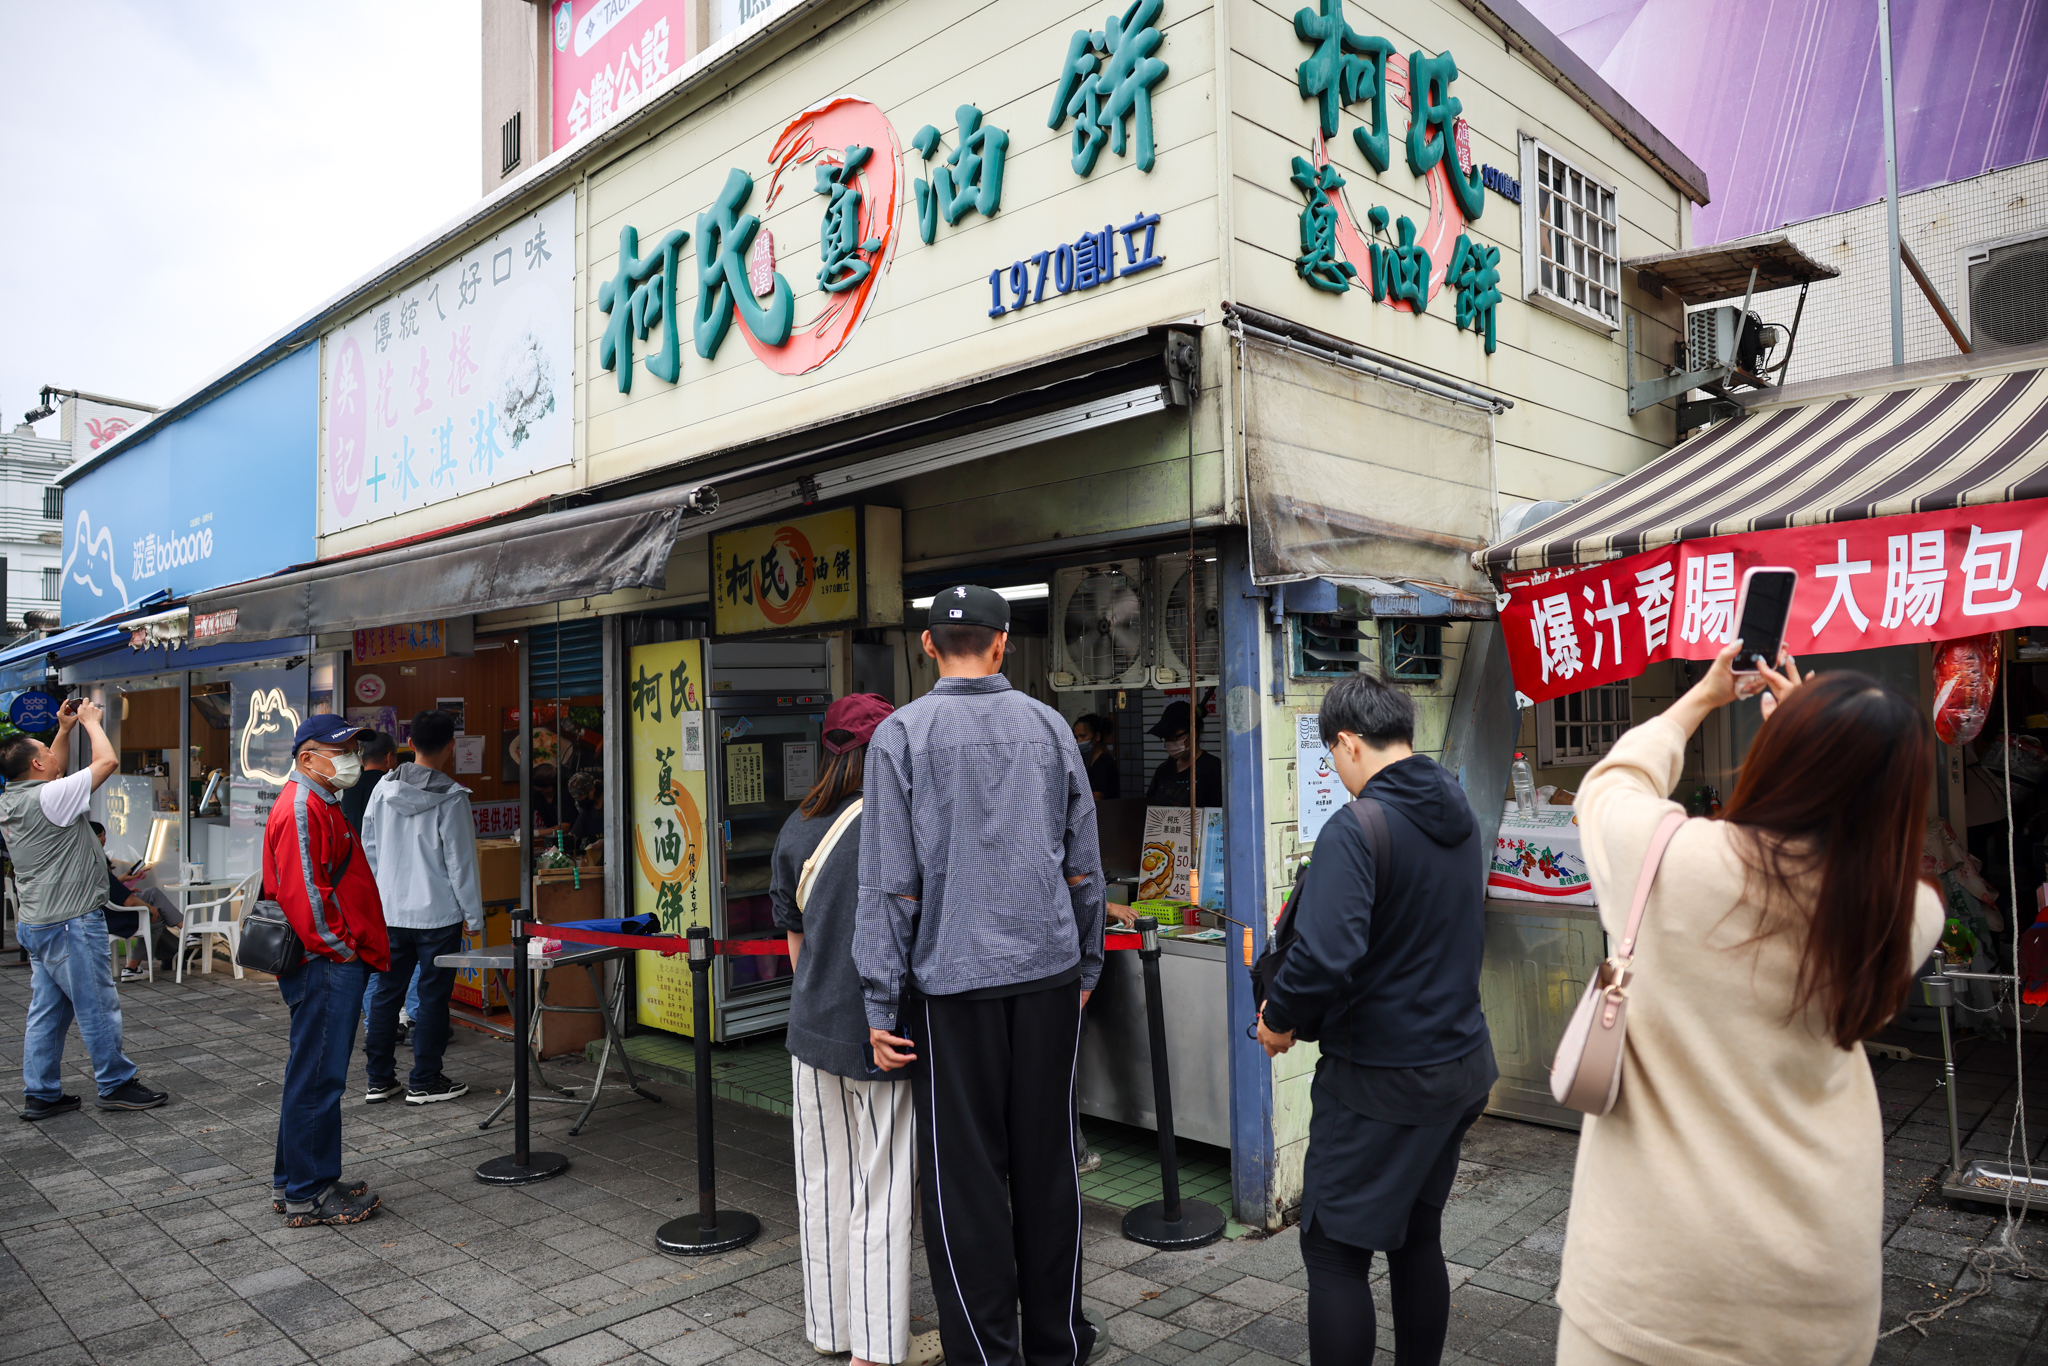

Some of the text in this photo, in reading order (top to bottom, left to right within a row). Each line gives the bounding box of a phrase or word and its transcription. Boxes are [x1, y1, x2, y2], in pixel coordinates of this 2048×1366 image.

[567, 16, 670, 137] 全齡公設
[1294, 0, 1484, 221] 柯氏
[988, 212, 1165, 318] 1970創立
[332, 361, 362, 498] 吳記
[821, 583, 850, 595] 1970創立
[1530, 552, 1736, 685] 爆汁香腸
[23, 697, 47, 705] boba
[1167, 815, 1179, 824] 柯氏
[1176, 855, 1189, 868] 50
